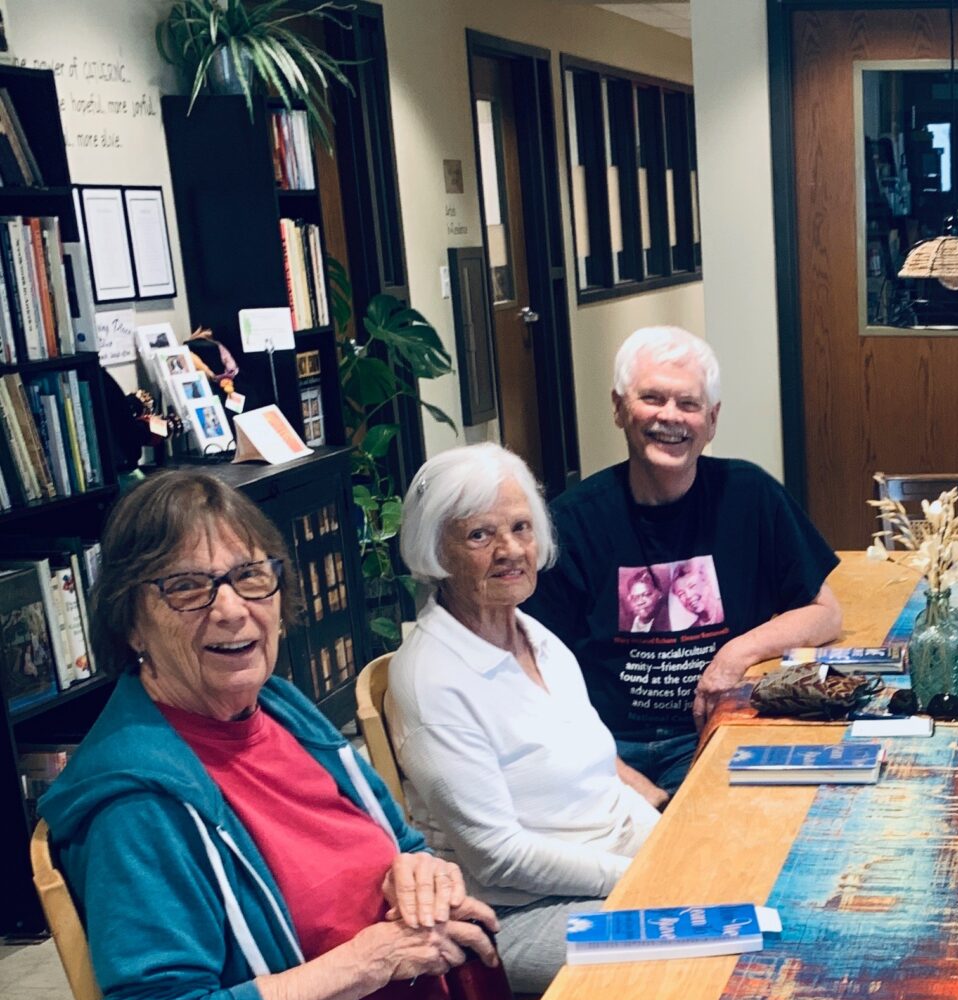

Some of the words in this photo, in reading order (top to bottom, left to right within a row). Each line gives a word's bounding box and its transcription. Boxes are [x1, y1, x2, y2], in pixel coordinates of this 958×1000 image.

[629, 648, 655, 659] Cross
[658, 642, 716, 659] racial/cultural
[619, 671, 649, 684] found
[651, 675, 661, 684] at
[663, 674, 680, 685] the
[630, 685, 675, 697] advances
[677, 686, 691, 697] for
[632, 699, 651, 709] and
[653, 700, 682, 710] social
